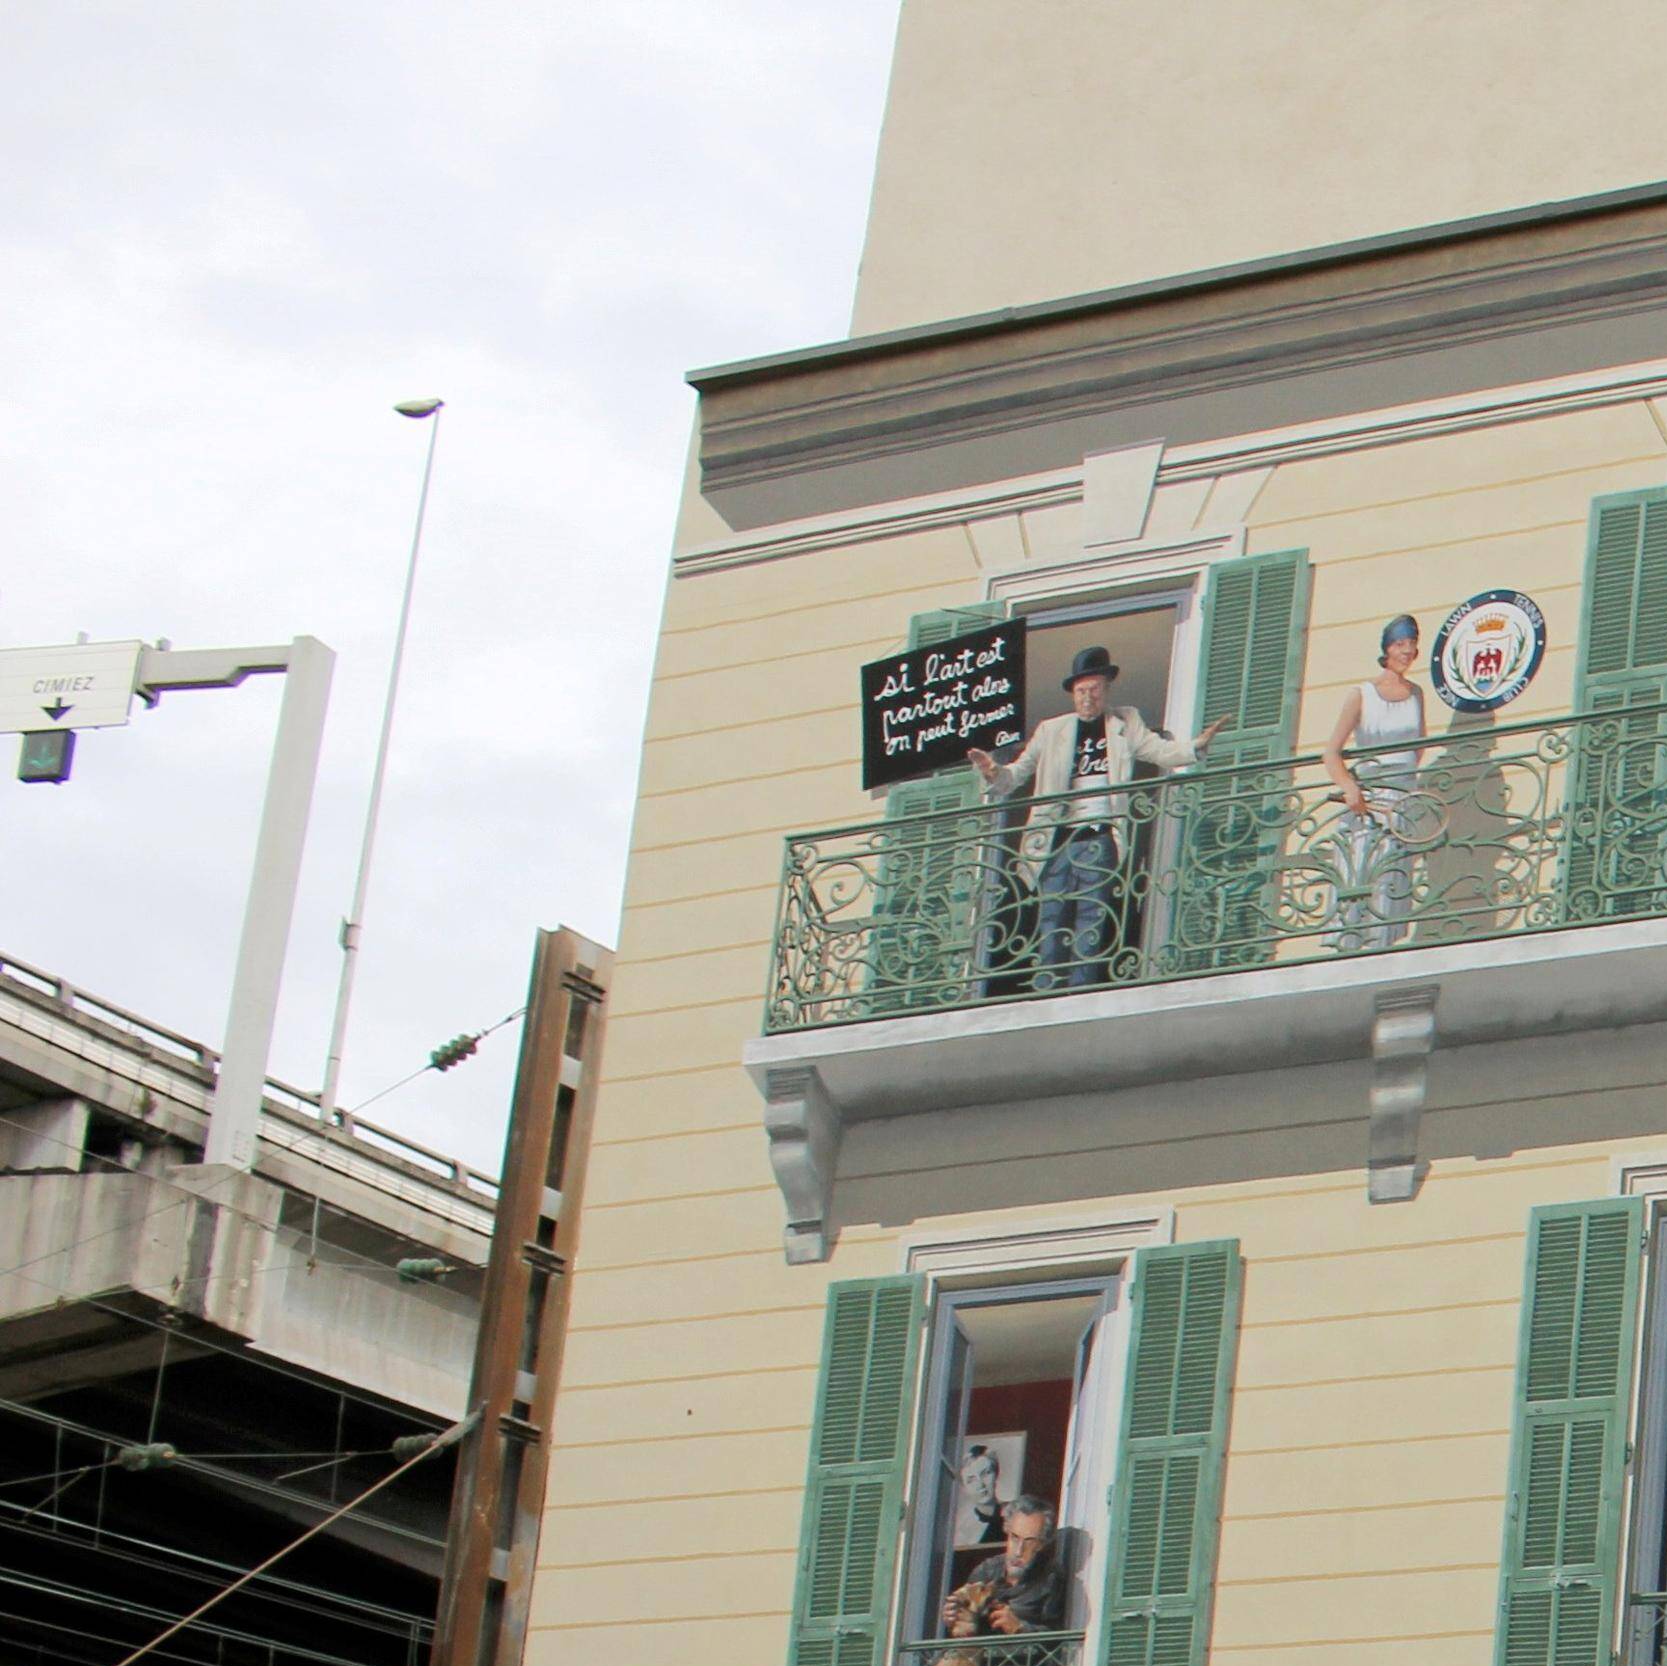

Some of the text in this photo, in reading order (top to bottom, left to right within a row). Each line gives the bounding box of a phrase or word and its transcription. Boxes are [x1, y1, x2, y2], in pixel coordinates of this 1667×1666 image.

[1440, 602, 1472, 637] LAWN
[33, 676, 95, 694] CIMIEZ
[874, 636, 1006, 701] si l'art est
[882, 675, 1011, 743] partout alors
[885, 703, 1015, 756] on peut fermer
